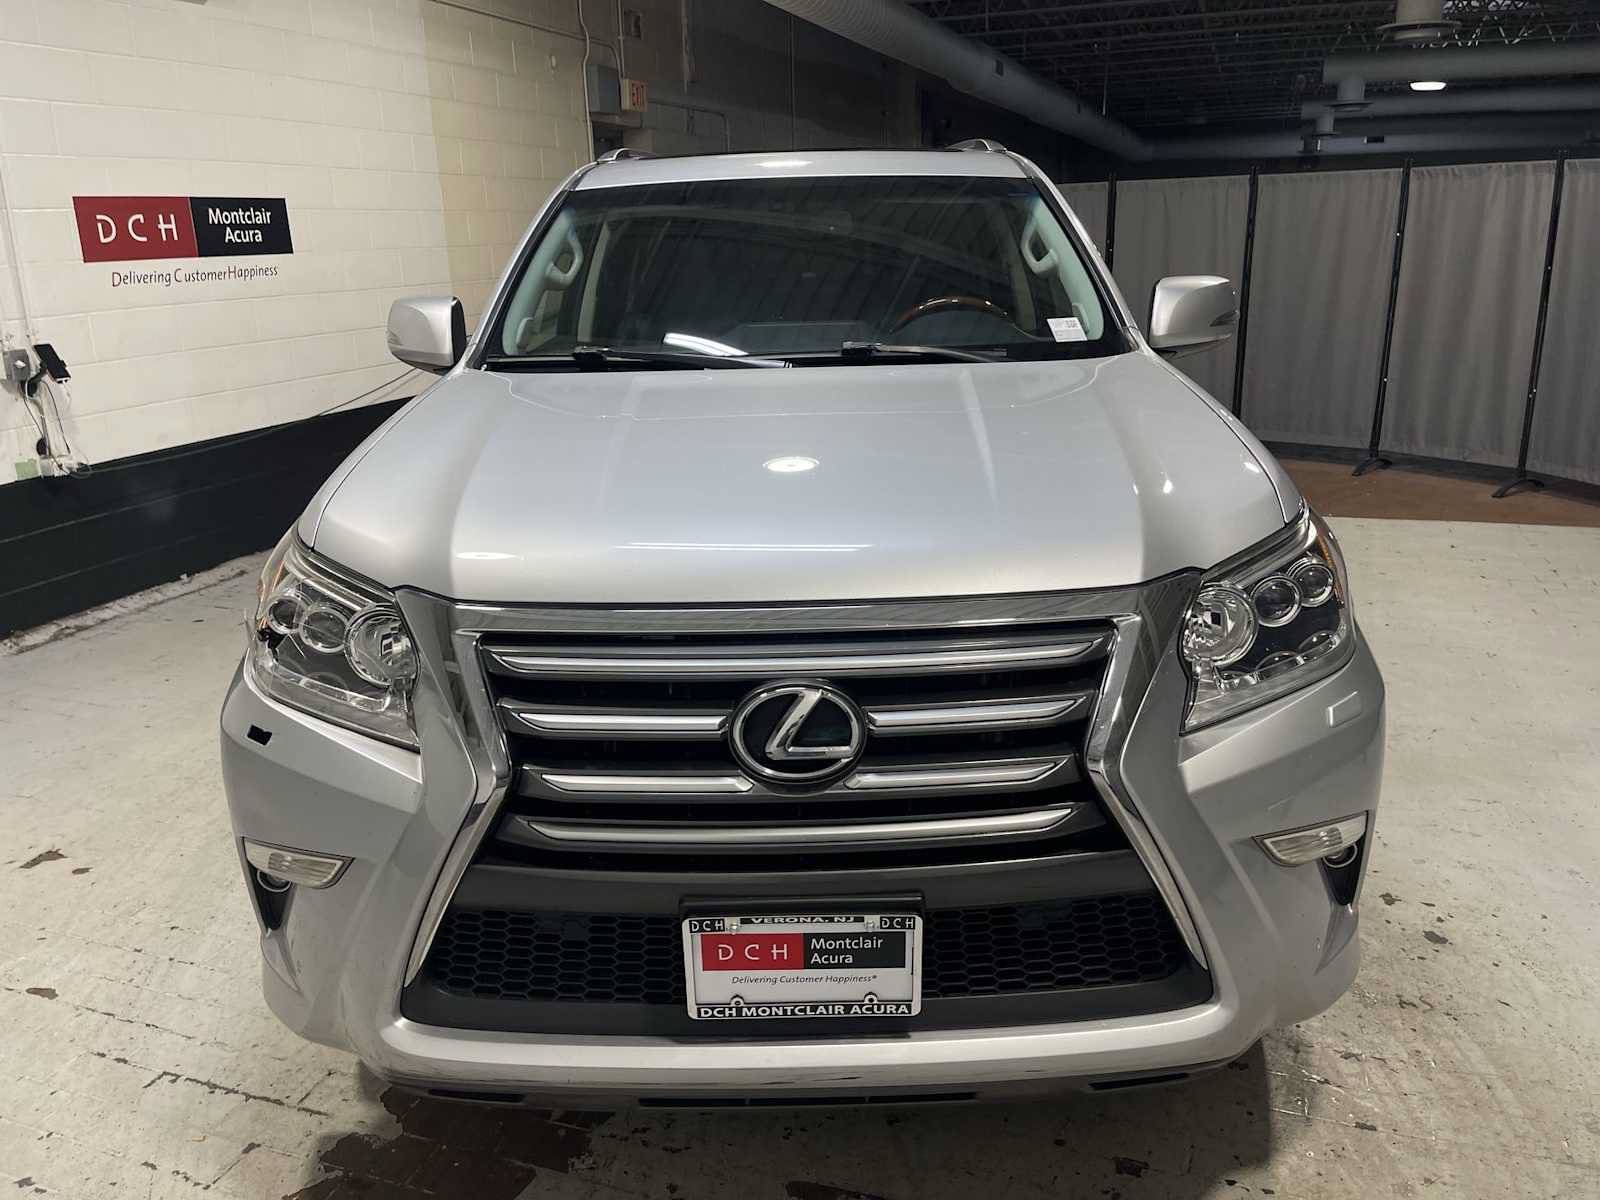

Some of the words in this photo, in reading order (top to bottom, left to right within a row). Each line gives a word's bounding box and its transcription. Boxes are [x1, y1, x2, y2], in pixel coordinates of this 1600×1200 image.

[208, 207, 271, 225] Montclair
[95, 213, 179, 244] DCH
[224, 226, 263, 244] Acura
[111, 272, 172, 288] Delivering
[691, 920, 725, 932] DCH
[881, 917, 914, 929] DCH
[810, 936, 884, 950] Montclair
[718, 943, 788, 961] DCH
[810, 952, 853, 965] Acura
[731, 975, 778, 985] Delivering
[779, 974, 824, 984] Customer
[701, 1007, 737, 1018] DCH
[742, 1006, 845, 1017] MONTCLAIR
[850, 1004, 909, 1016] ACURA
